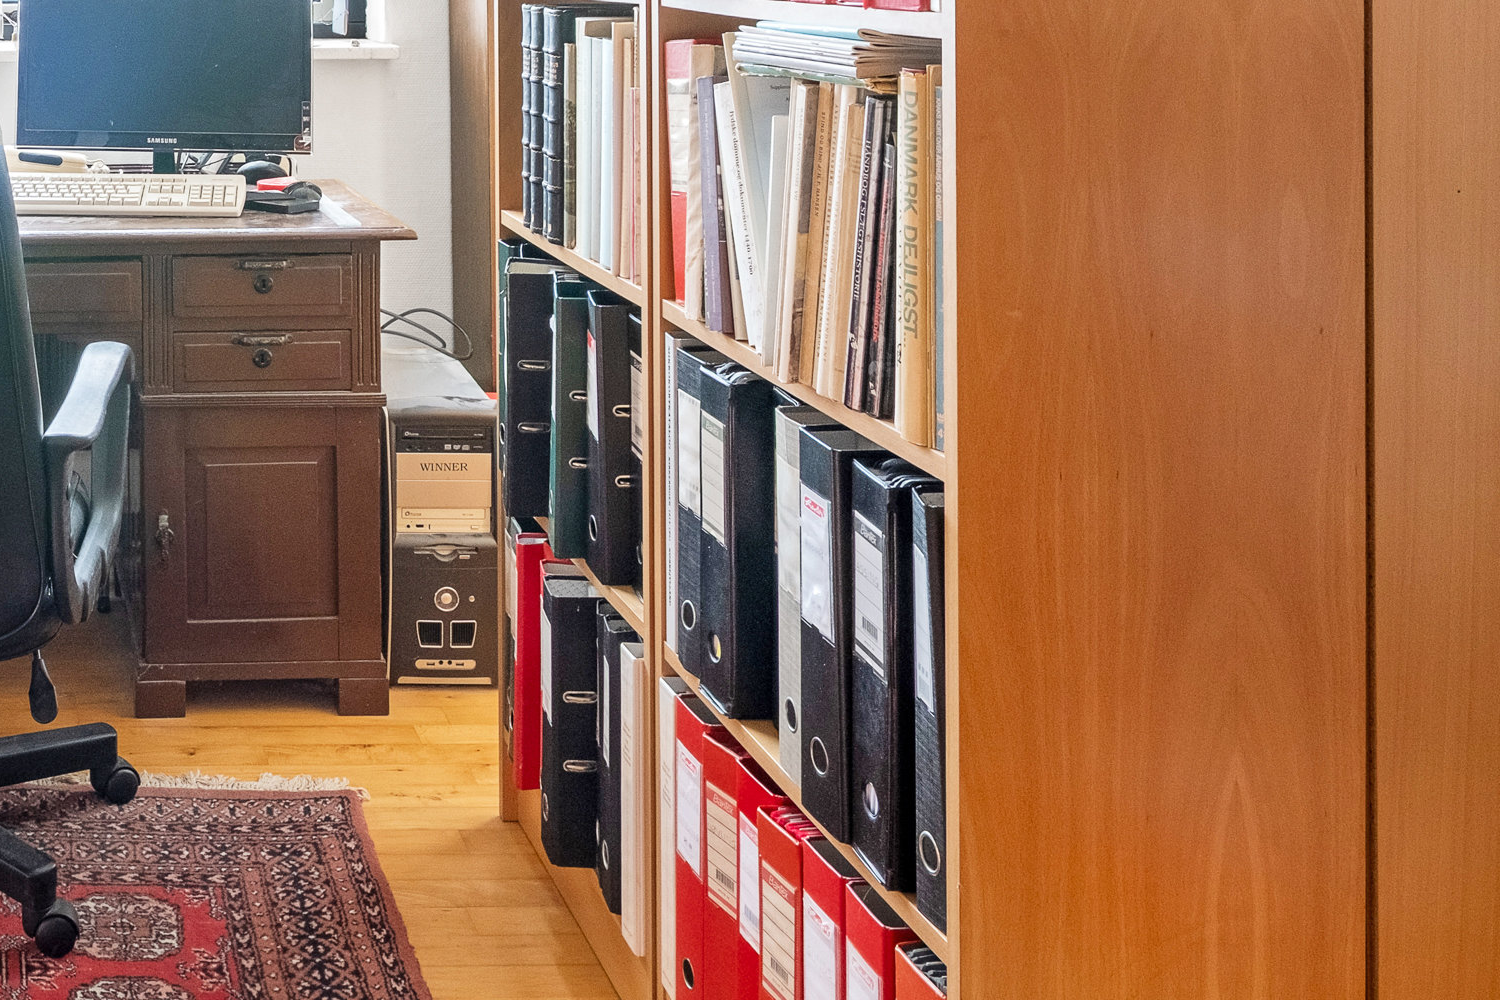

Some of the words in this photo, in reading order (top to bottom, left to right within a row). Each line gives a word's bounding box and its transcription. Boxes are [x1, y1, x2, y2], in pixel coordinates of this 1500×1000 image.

[903, 91, 918, 215] DANMARK
[419, 462, 469, 472] WINNER
[768, 873, 790, 900] Bantex
